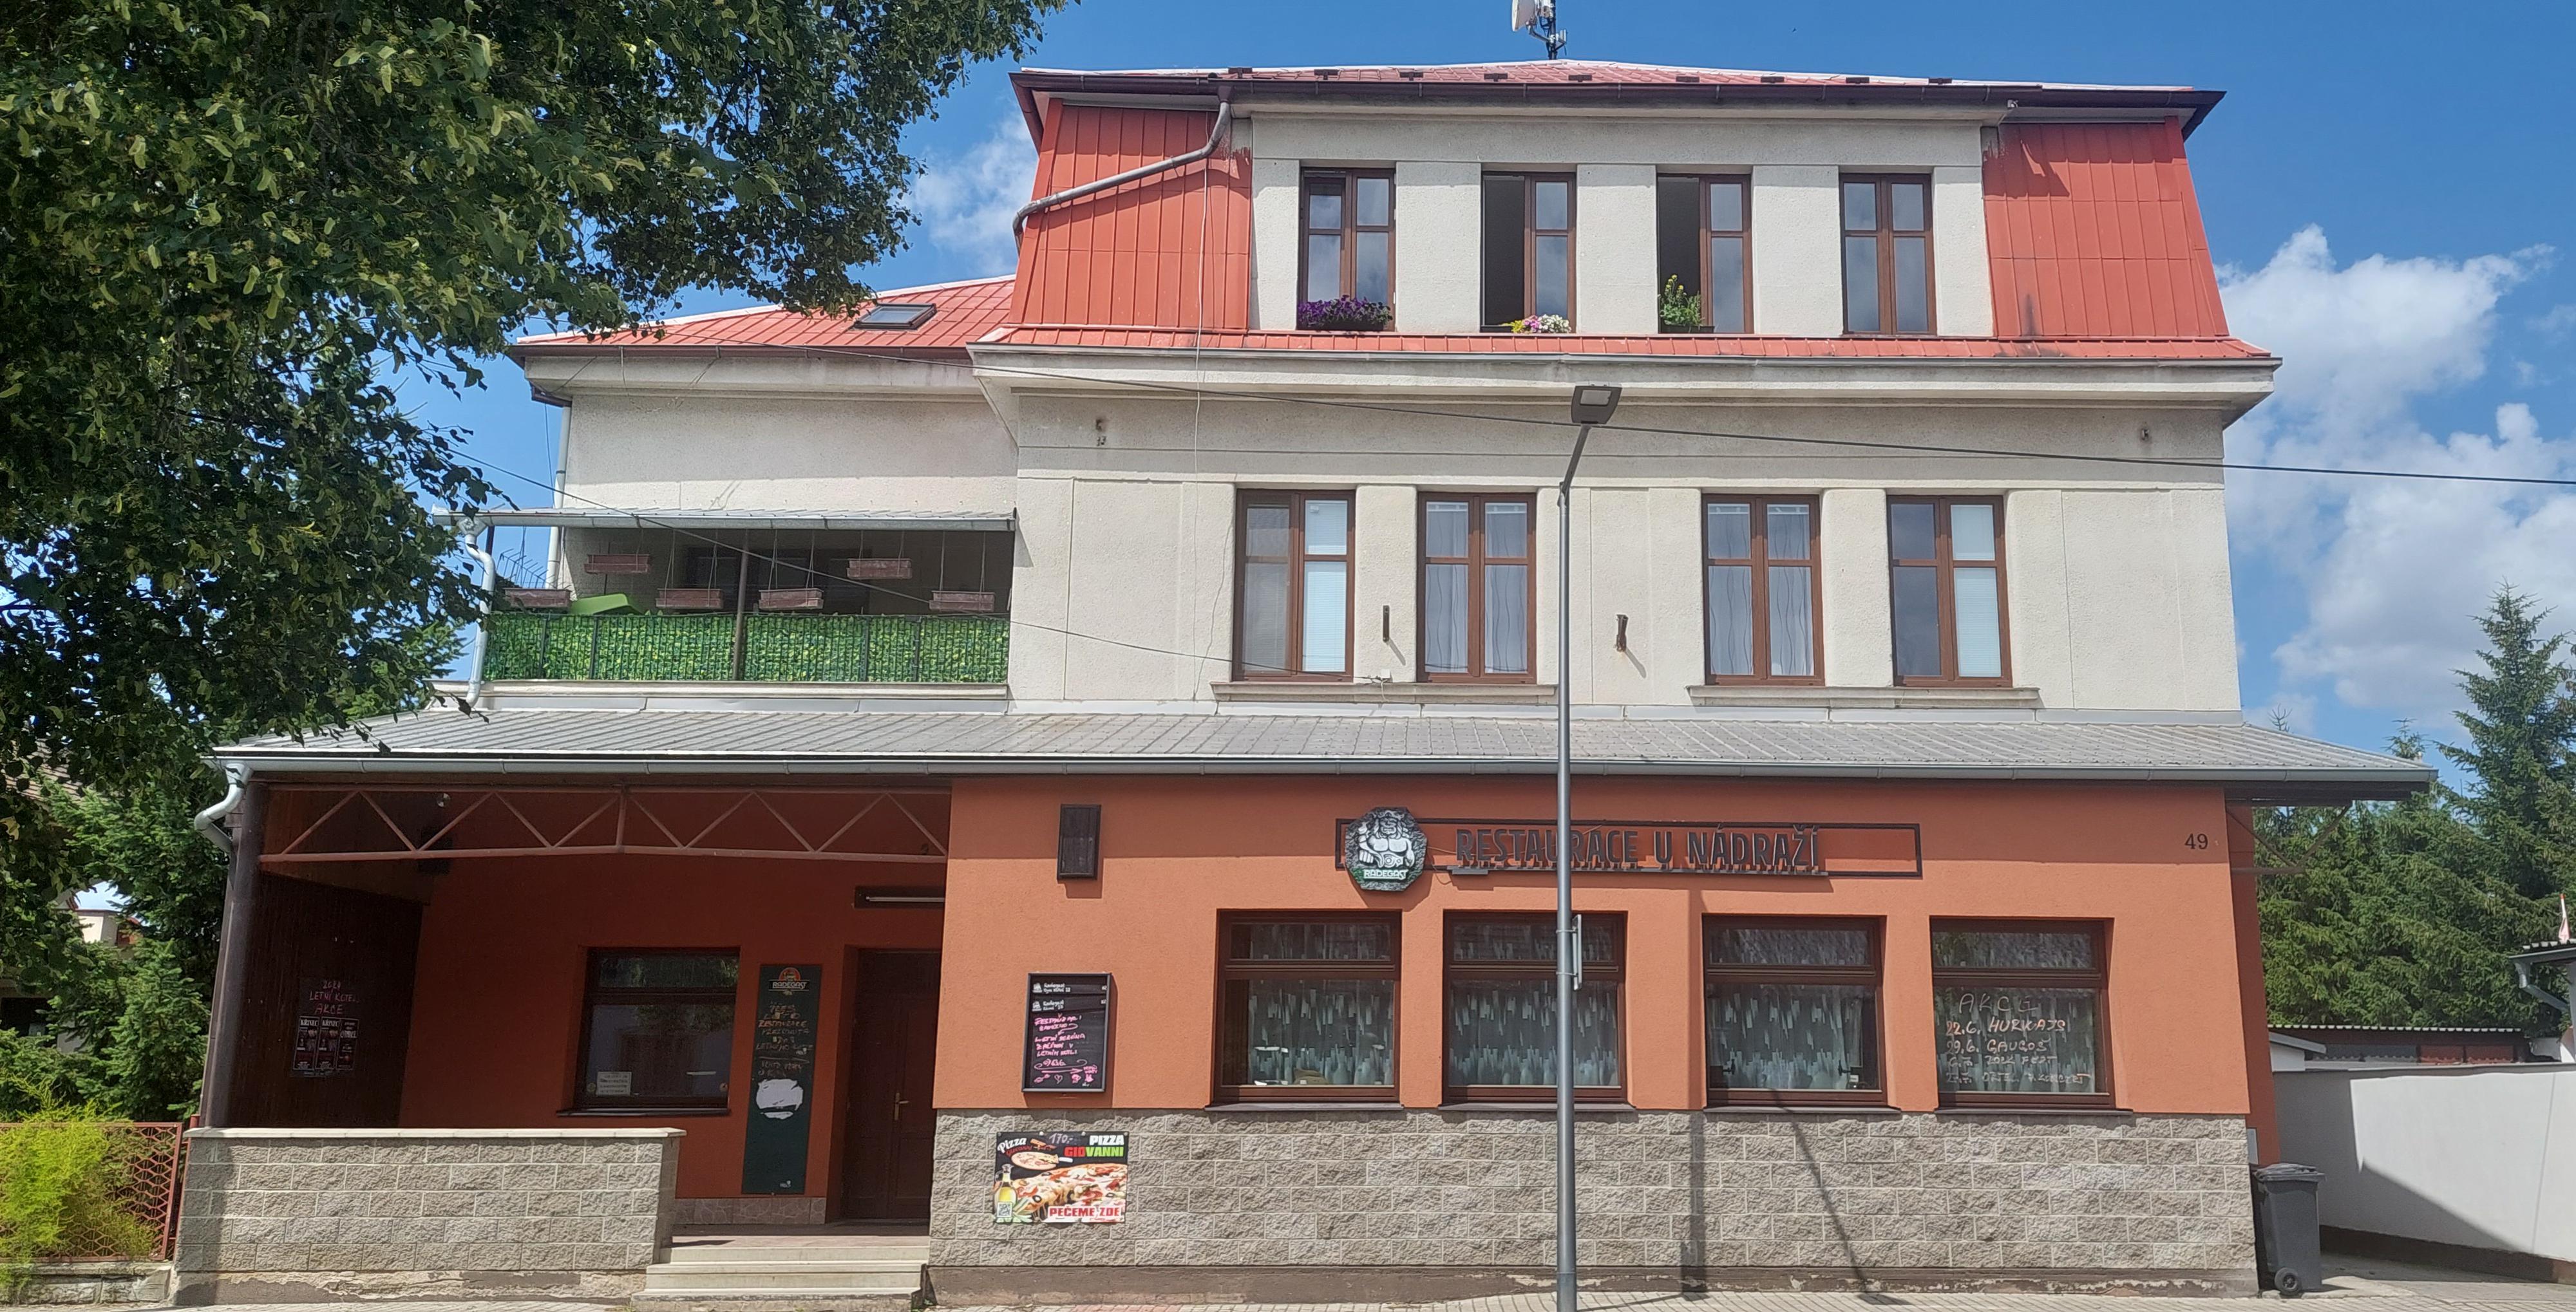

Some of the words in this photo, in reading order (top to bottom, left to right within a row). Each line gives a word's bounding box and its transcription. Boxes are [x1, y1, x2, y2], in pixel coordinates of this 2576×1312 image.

[1456, 828, 1638, 863] RESTAURACE
[1654, 830, 1672, 864] U
[1687, 824, 1819, 867] NÁDRAŽÍ
[2184, 833, 2208, 850] 49
[1363, 868, 1409, 880] RADEGAST
[1958, 993, 2039, 1013] AKCE
[1946, 1021, 1980, 1036] 22.6.
[1946, 1039, 1979, 1054] 29.6.
[997, 1138, 1027, 1154] Pizza
[1089, 1134, 1125, 1146] PIZZA
[1064, 1146, 1124, 1157] GIOVANNI
[1049, 1205, 1095, 1217] PEČEME
[1099, 1207, 1120, 1217] ZDE
